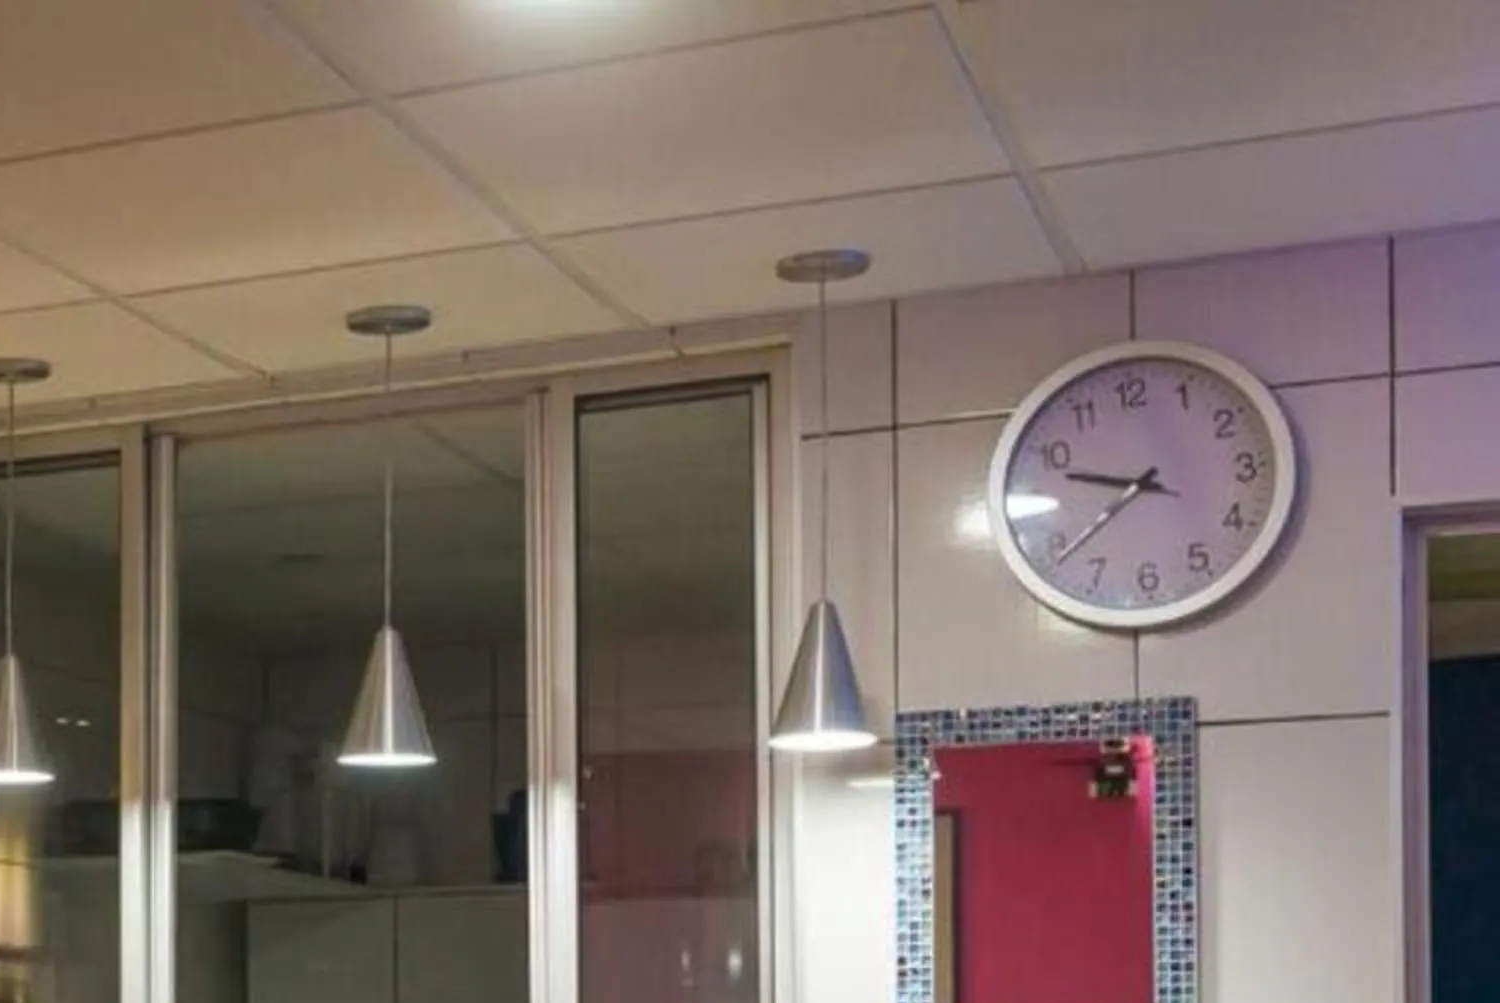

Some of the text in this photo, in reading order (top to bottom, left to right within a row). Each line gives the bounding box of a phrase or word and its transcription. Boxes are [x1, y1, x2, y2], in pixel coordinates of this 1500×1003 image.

[1114, 378, 1148, 408] 12
[1176, 384, 1190, 410] 1
[1072, 401, 1096, 432] 11
[1213, 409, 1236, 439] 2
[1041, 442, 1071, 469] 10
[1235, 452, 1258, 484] 3
[1223, 502, 1243, 532] 4
[1088, 557, 1107, 588] 7
[1189, 543, 1211, 572] 5
[1138, 564, 1161, 592] 6
